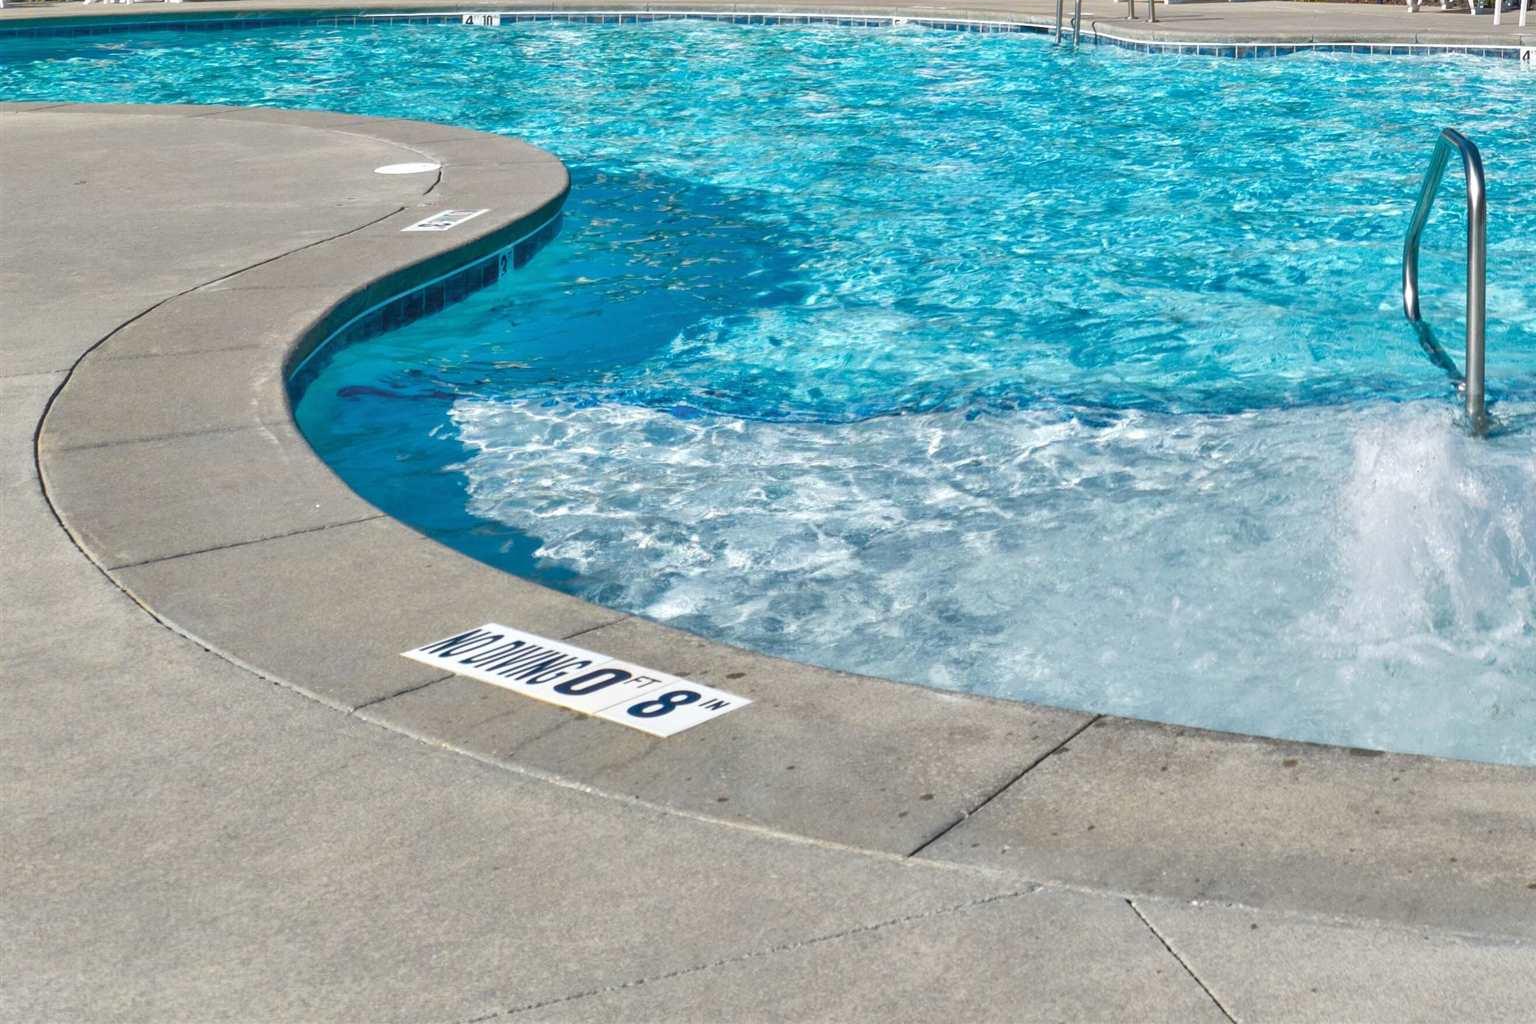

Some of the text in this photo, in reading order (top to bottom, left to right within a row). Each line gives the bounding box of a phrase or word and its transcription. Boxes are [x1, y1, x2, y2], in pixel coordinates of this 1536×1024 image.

[465, 15, 474, 25] 4
[419, 628, 731, 718] NO DIVING 0 FT 8 IN
